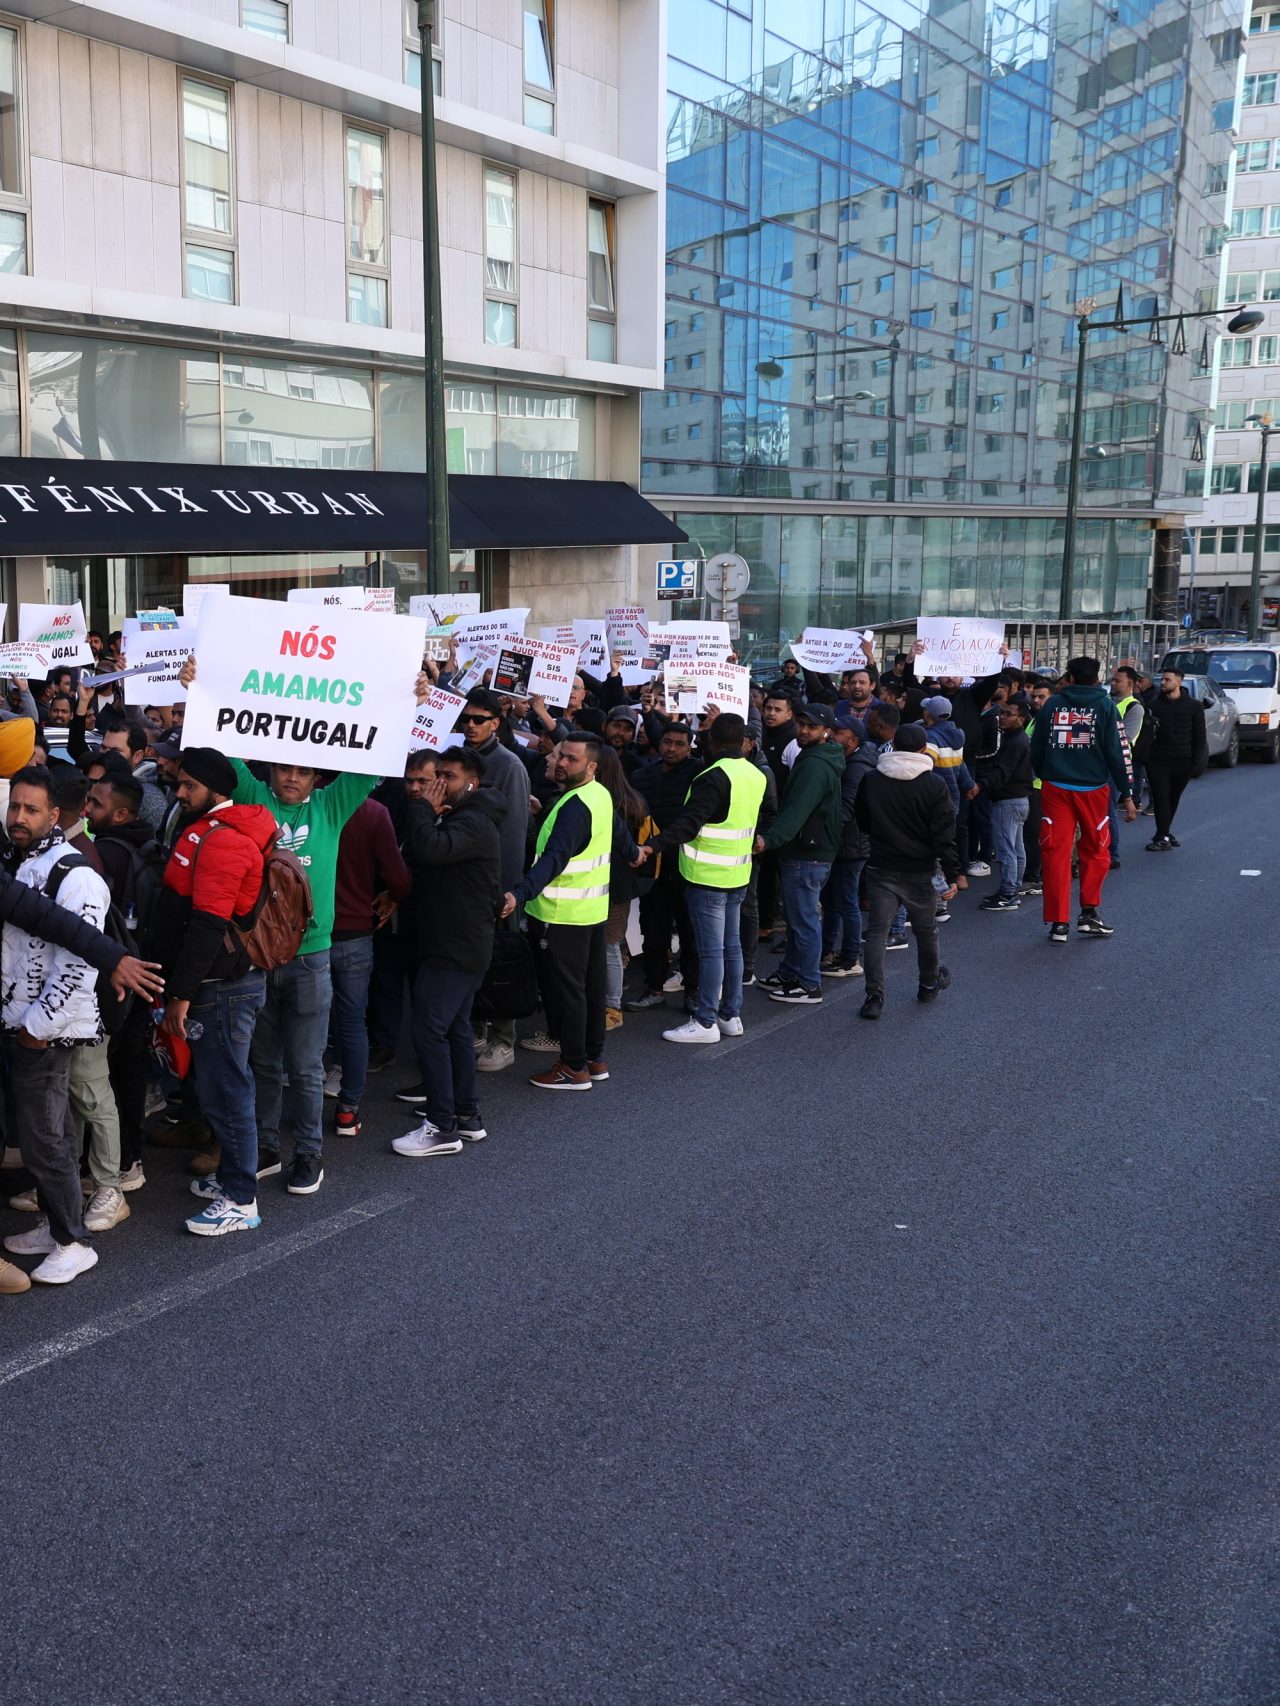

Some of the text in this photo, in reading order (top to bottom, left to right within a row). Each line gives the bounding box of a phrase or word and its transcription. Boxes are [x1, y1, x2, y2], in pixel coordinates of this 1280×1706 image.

[211, 489, 384, 515] URBAN
[661, 563, 678, 587] P
[52, 612, 71, 627] NÓS
[37, 629, 75, 642] AMAMOS
[467, 624, 489, 632] ALERTAS
[280, 625, 337, 661] NÓS
[485, 633, 496, 641] DOS
[504, 634, 524, 645] AIMA
[526, 639, 544, 650] POR
[546, 643, 576, 656] FAVOR
[145, 648, 189, 658] ALERTAS DO
[512, 645, 562, 662] AJUDE-NOS
[546, 663, 561, 673] SIS
[682, 668, 736, 680] AJUDE-NOS
[719, 663, 746, 674] FAVOR
[535, 671, 568, 684] ALERTA
[240, 669, 365, 706] AMAMOS
[717, 682, 734, 692] SIS
[432, 690, 462, 707] FAVOR
[706, 691, 743, 706] ALERTA
[216, 708, 378, 750] PORTUGAL!
[415, 714, 434, 729] SIS
